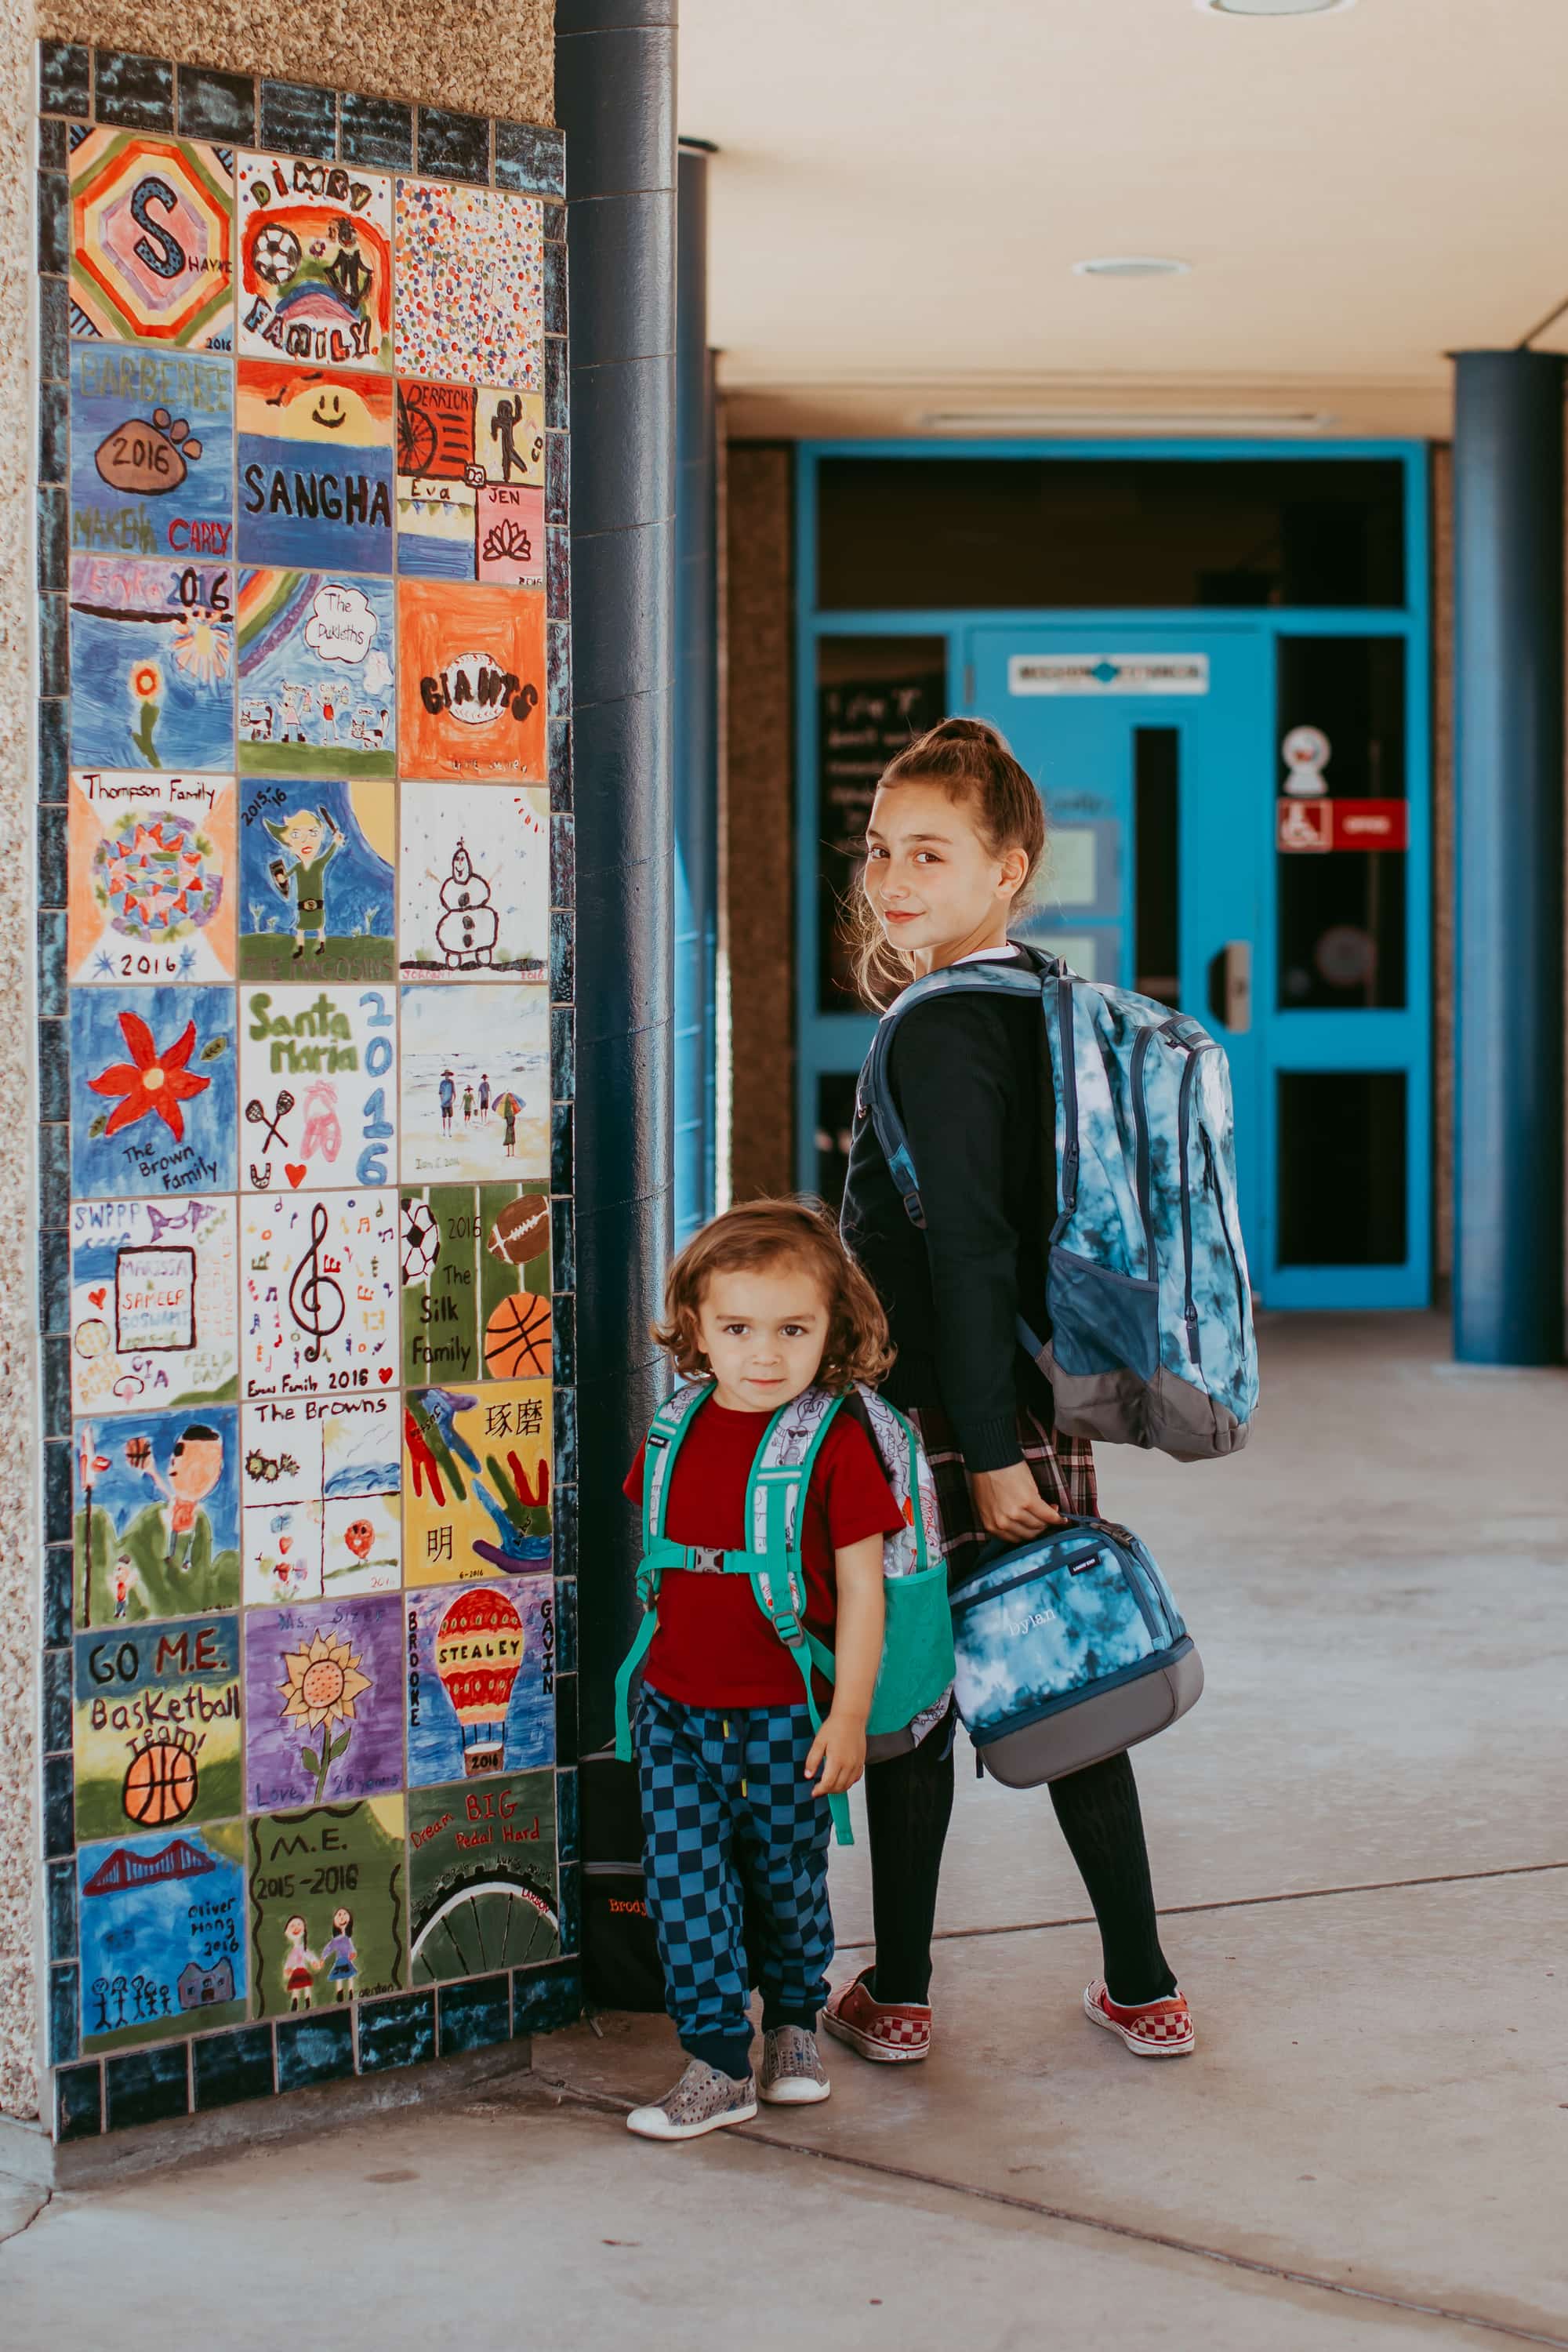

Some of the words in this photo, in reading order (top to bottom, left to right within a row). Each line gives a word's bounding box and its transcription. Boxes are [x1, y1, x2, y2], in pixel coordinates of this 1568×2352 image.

[205, 338, 232, 350] 2016
[243, 296, 371, 361] FAMILY
[406, 385, 470, 411] DERRICK
[112, 437, 169, 475] 2016
[245, 463, 391, 528] SANGHA
[412, 478, 450, 500] Eva
[488, 487, 521, 506] JEN
[168, 517, 233, 558] CARLY
[325, 593, 351, 613] The
[420, 666, 538, 721] GIANTS
[82, 774, 161, 802] Thompson
[170, 779, 215, 810] Family
[121, 953, 176, 976] 2016
[249, 992, 352, 1042] Santa
[270, 1038, 359, 1074] Maria
[356, 991, 394, 1186] 2016
[122, 1142, 156, 1163] The
[138, 1145, 195, 1177] Brown
[162, 1156, 218, 1191] Family
[74, 1202, 140, 1231] SWPPP
[448, 1216, 482, 1239] 2016
[443, 1264, 472, 1285] The
[419, 1294, 459, 1324] Silk
[412, 1335, 471, 1372] Family
[328, 1368, 368, 1389] 2016
[255, 1403, 296, 1423] The
[306, 1398, 387, 1421] Browns
[485, 1398, 543, 1438] 琢磨
[426, 1525, 453, 1563] 明
[459, 1570, 484, 1580] 6-2016
[89, 1641, 140, 1685] GO
[156, 1628, 227, 1675] M.E.
[438, 1639, 521, 1664] STEALEY
[540, 1600, 554, 1695] GAVIN
[407, 1610, 421, 1726] BROOKE
[125, 1725, 208, 1756] Team!
[470, 1755, 499, 1770] 2016
[410, 1813, 456, 1850] Dream
[465, 1789, 518, 1821] BIG
[455, 1824, 493, 1850] Pedal
[502, 1817, 540, 1843] Hard
[270, 1828, 348, 1862] M.E.
[187, 1897, 237, 1919] Oliver
[521, 1888, 550, 1914] LARSON
[191, 1918, 235, 1940] Hong
[203, 1939, 240, 1957] 2016
